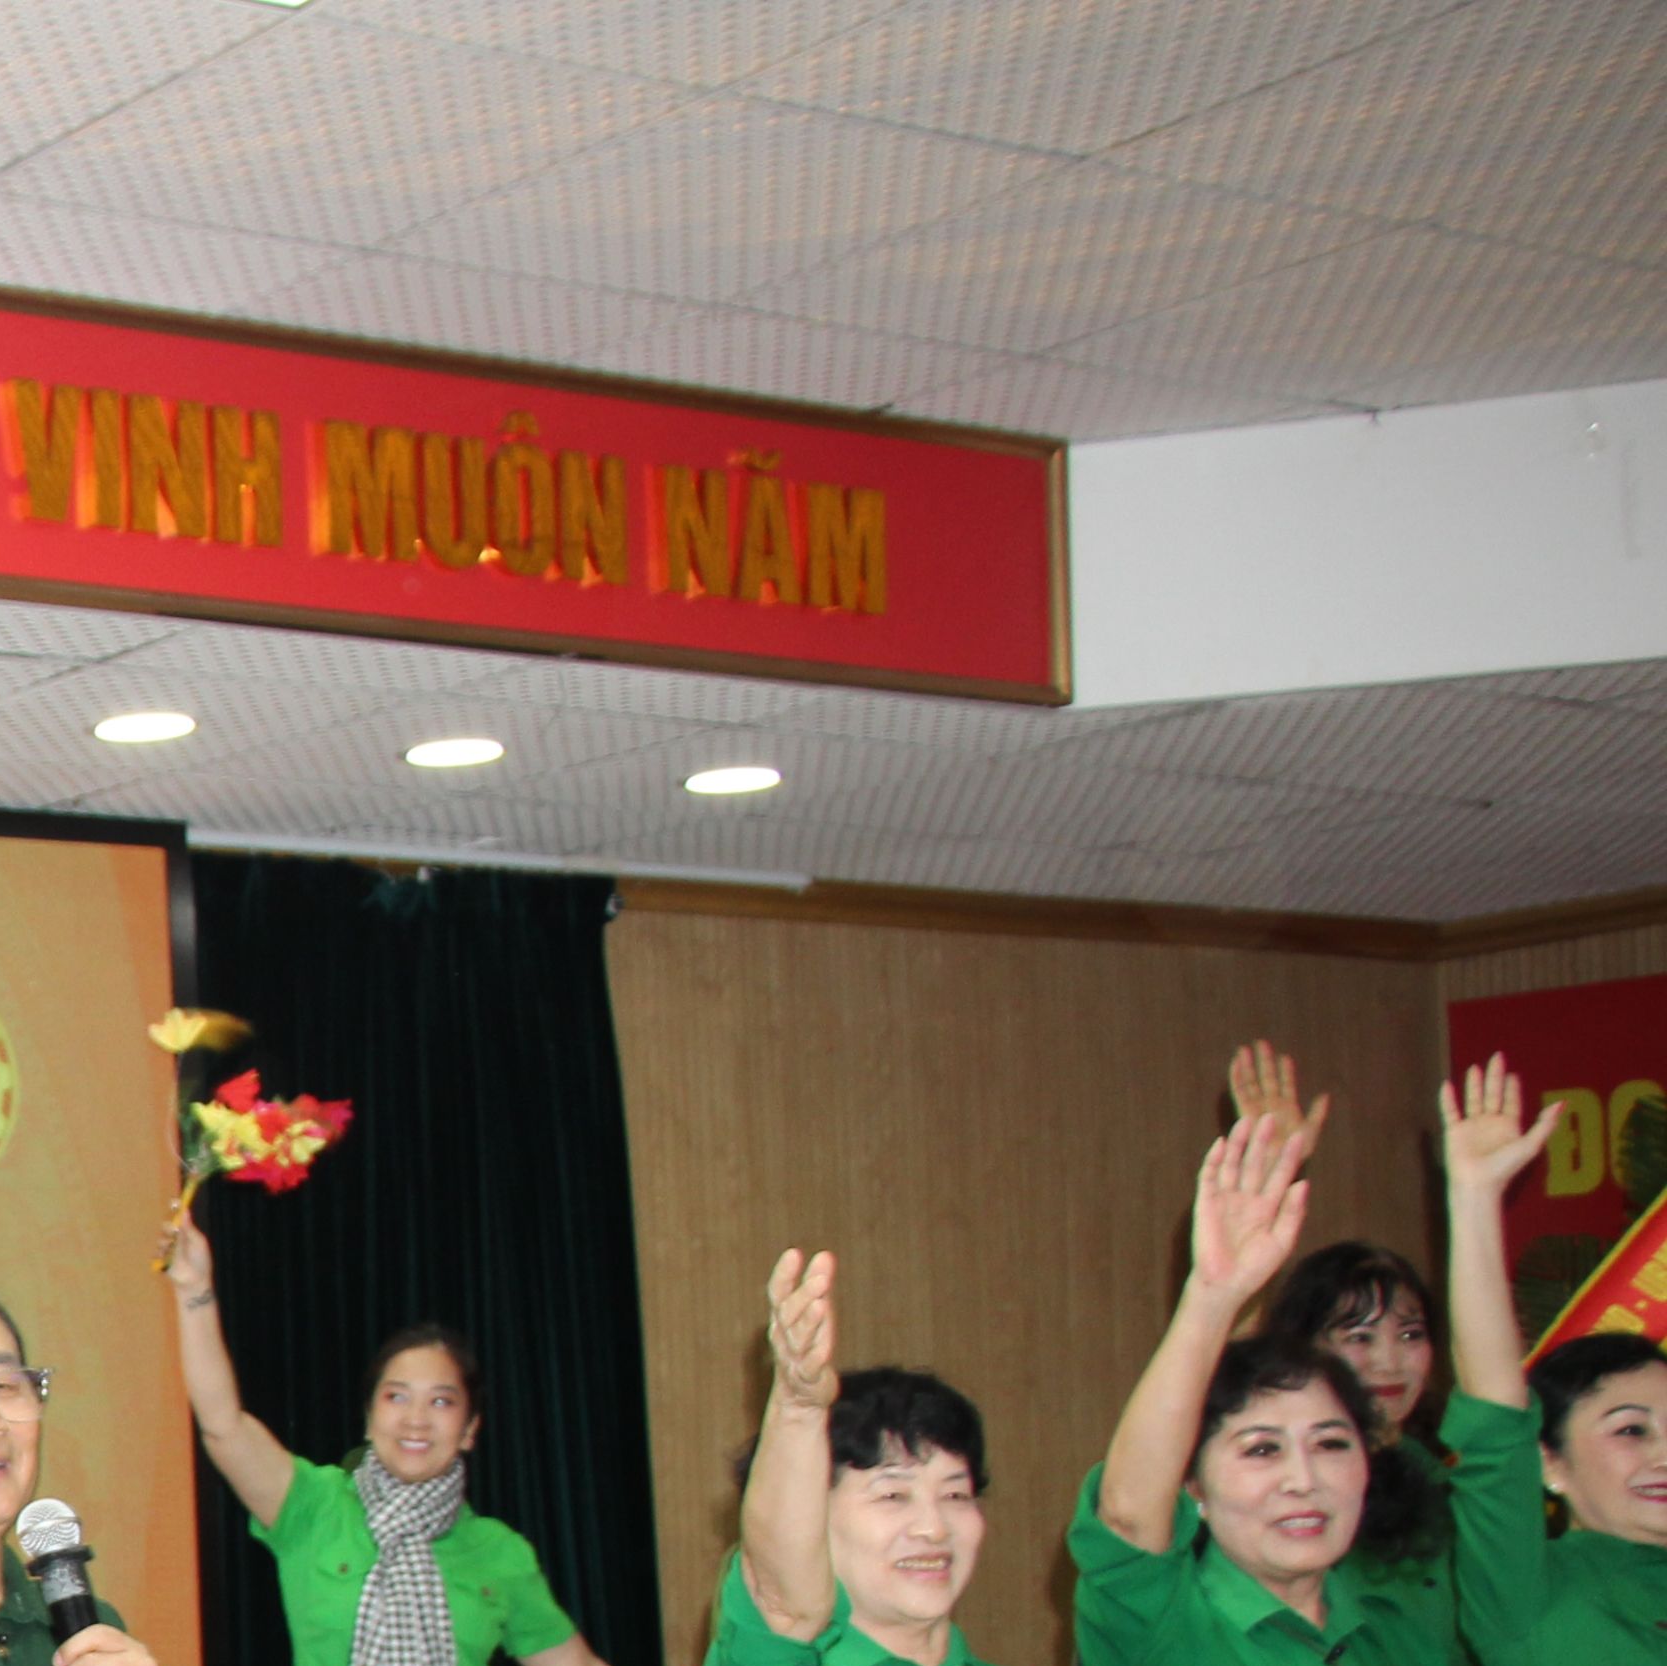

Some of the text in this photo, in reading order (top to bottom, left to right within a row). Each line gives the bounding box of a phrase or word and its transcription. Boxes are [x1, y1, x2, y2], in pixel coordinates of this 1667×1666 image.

[0, 377, 283, 547] VINH
[313, 411, 631, 587] MUÔN
[647, 447, 888, 615] NĂM
